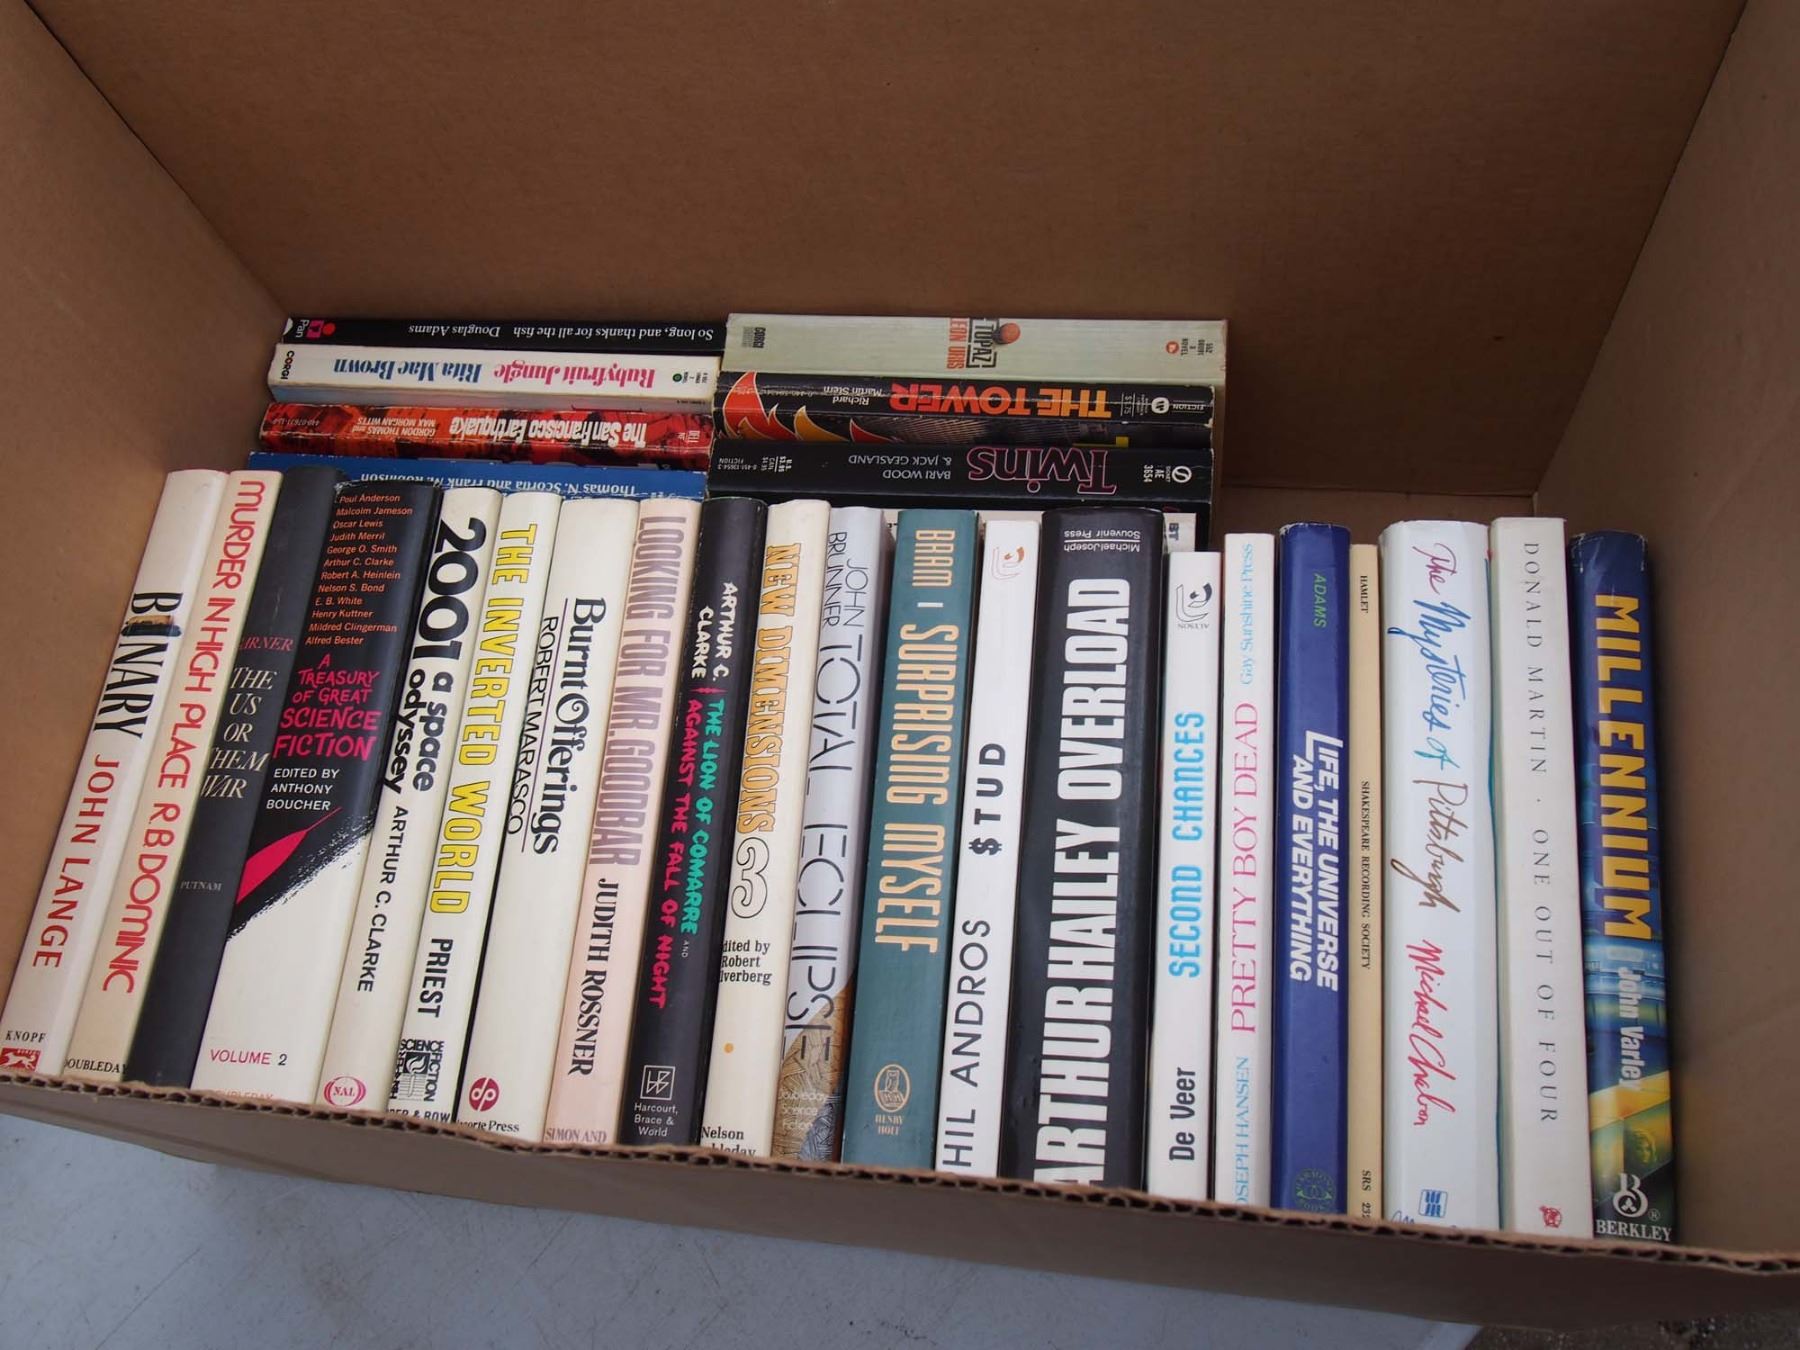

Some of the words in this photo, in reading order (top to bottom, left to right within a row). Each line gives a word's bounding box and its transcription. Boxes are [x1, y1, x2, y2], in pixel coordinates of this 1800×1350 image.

[295, 320, 310, 338] Pan
[408, 326, 449, 335] Adams
[452, 326, 501, 338] Douglas
[513, 326, 535, 337] fish
[595, 328, 636, 340] thanks
[664, 328, 698, 340] long,
[753, 327, 766, 348] CORGI
[971, 323, 994, 368] TOPAZ
[280, 350, 294, 380] CORGI
[333, 358, 396, 380] Brown
[398, 362, 436, 382] Mae
[442, 364, 482, 383] Rita
[494, 360, 561, 385] Jungle
[562, 363, 656, 388] Rubyfruit
[832, 395, 869, 406] Richard
[888, 382, 1031, 416] TOWER
[449, 416, 527, 445] Earthquake
[528, 420, 588, 448] Francisco
[588, 420, 622, 448] San
[848, 455, 910, 464] GEASLAND
[882, 469, 922, 480] WOOD
[912, 456, 940, 466] JACK
[925, 470, 951, 480] BARI
[967, 446, 1116, 494] Twins
[1143, 464, 1153, 483] 3654
[336, 508, 371, 516] Malcolm
[374, 506, 413, 516] Jameson
[360, 494, 401, 502] Anderson
[212, 480, 266, 590] MURDER
[330, 533, 355, 542] Judith
[358, 532, 386, 540] Merril
[332, 520, 357, 529] Oscar
[359, 519, 384, 528] Lewis
[1064, 529, 1092, 538] Press
[1096, 529, 1141, 540] Souvenir
[324, 559, 350, 568] Arthur
[364, 558, 394, 566] Clarke
[327, 546, 357, 556] George
[370, 545, 398, 554] Smith
[626, 516, 687, 620] LOOKING
[912, 530, 956, 588] BRAM
[1240, 544, 1253, 582] Press
[318, 584, 347, 593] Nelson
[360, 584, 384, 592] Bond
[320, 572, 350, 580] Robert
[363, 571, 400, 580] Heinlein
[412, 516, 488, 661] 2001
[760, 542, 802, 617] NEW
[822, 531, 848, 630] BRUNNER
[843, 558, 868, 628] JOHN
[1360, 575, 1369, 614] HAMLET
[1524, 542, 1543, 648] DONALD
[312, 610, 336, 620] Henry
[338, 610, 374, 618] Kuttner
[338, 596, 364, 606] White
[714, 582, 740, 660] ARTHUR
[1240, 585, 1253, 652] Sunshine
[1314, 573, 1327, 629] ADAMS
[305, 636, 332, 645] Alfred
[334, 636, 364, 645] Bester
[309, 623, 342, 633] Mildred
[344, 623, 398, 634] Clingerman
[560, 597, 607, 690] Burnt
[618, 629, 672, 677] FOR
[691, 606, 714, 680] CLARKE
[93, 592, 184, 740] BINARY
[184, 627, 229, 693] HIGH
[298, 668, 380, 688] TREASURY
[458, 597, 524, 766] INVERTED
[528, 616, 559, 706] ROBERT
[1240, 656, 1253, 685] Gay
[1387, 599, 1472, 732] Mysteries
[318, 688, 373, 706] GREAT
[1057, 578, 1130, 800] OVERLOAD
[280, 706, 383, 731] SCIENCE
[383, 668, 426, 794] odyssey
[736, 624, 794, 834] DIMENSIONS
[806, 634, 863, 796] TOTAL
[886, 624, 959, 805] SURPRISING
[1528, 666, 1547, 774] MARTIN
[157, 703, 207, 789] PLACE
[272, 732, 378, 761] FICTION
[412, 702, 448, 792] space
[677, 700, 704, 788] AGAINST
[699, 741, 720, 790] LION
[1234, 702, 1258, 798] DEAD
[1306, 730, 1344, 791] LIFE,
[1595, 594, 1653, 940] MILLENNIUM
[201, 776, 248, 799] WAR
[270, 784, 334, 795] ANTHONY
[273, 768, 317, 778] EDITED
[508, 711, 542, 834] MARASCO
[530, 693, 590, 855] Offerings
[1172, 712, 1205, 841] CHANCES
[69, 754, 121, 844] JOHN
[266, 800, 332, 811] BOUCHER
[588, 738, 656, 866] GOODBAR
[968, 742, 1006, 856] $TUD
[1361, 780, 1370, 852] SHAKESPEARE
[379, 806, 409, 884] ARTHUR
[430, 780, 491, 914] WORLD
[664, 842, 686, 892] FALL
[1232, 808, 1258, 877] BOY
[1390, 779, 1469, 913] Pittsburgh
[1532, 830, 1550, 886] ONE
[180, 881, 222, 892] PUTNAM
[681, 830, 710, 935] COMARRE
[874, 822, 946, 954] MYSELF
[1047, 819, 1120, 980] HAILEY
[1290, 814, 1314, 982] EVERYTHING
[1361, 856, 1370, 918] RECORDING
[32, 858, 91, 968] LANGE
[102, 853, 169, 994] DOMINIC
[586, 878, 618, 963] JUDITH
[1168, 864, 1203, 978] SECOND
[1317, 853, 1339, 992] UNIVERSE
[1535, 906, 1554, 964] OUT
[357, 914, 387, 992] CLARKE
[722, 940, 750, 952] dited
[755, 940, 770, 956] by
[722, 954, 760, 968] Robert
[782, 824, 848, 1062] ECLIPSE
[1232, 888, 1258, 1032] PRETTY
[1361, 922, 1370, 970] SOCIETY
[418, 938, 454, 1018] PRIEST
[648, 934, 676, 1010] NIGHT
[1406, 939, 1448, 1039] Michael
[1618, 966, 1642, 1019] John
[568, 970, 607, 1076] ROSSNER
[950, 920, 990, 1088] ANDROS
[5, 1030, 47, 1043] KNOPF
[210, 1050, 272, 1065] VOLUME
[400, 1038, 445, 1052] SCIENCE
[1619, 1026, 1646, 1092] Varley
[424, 1052, 444, 1102] FICTION
[1170, 1067, 1196, 1120] Veer
[1236, 1056, 1249, 1137] HANSEN
[1407, 1033, 1457, 1127] Chabon
[1538, 1042, 1558, 1122] FOUR
[488, 1120, 520, 1133] Press
[634, 1102, 679, 1116] Harcourt,
[634, 1114, 662, 1126] Brace
[638, 1126, 669, 1138] World
[702, 1126, 744, 1141] Nelson
[874, 1115, 904, 1125] HENRY
[544, 1127, 582, 1142] SIMON
[1169, 1131, 1195, 1162] De
[1362, 1170, 1371, 1192] SRS
[1596, 1219, 1672, 1242] BERKLEY
